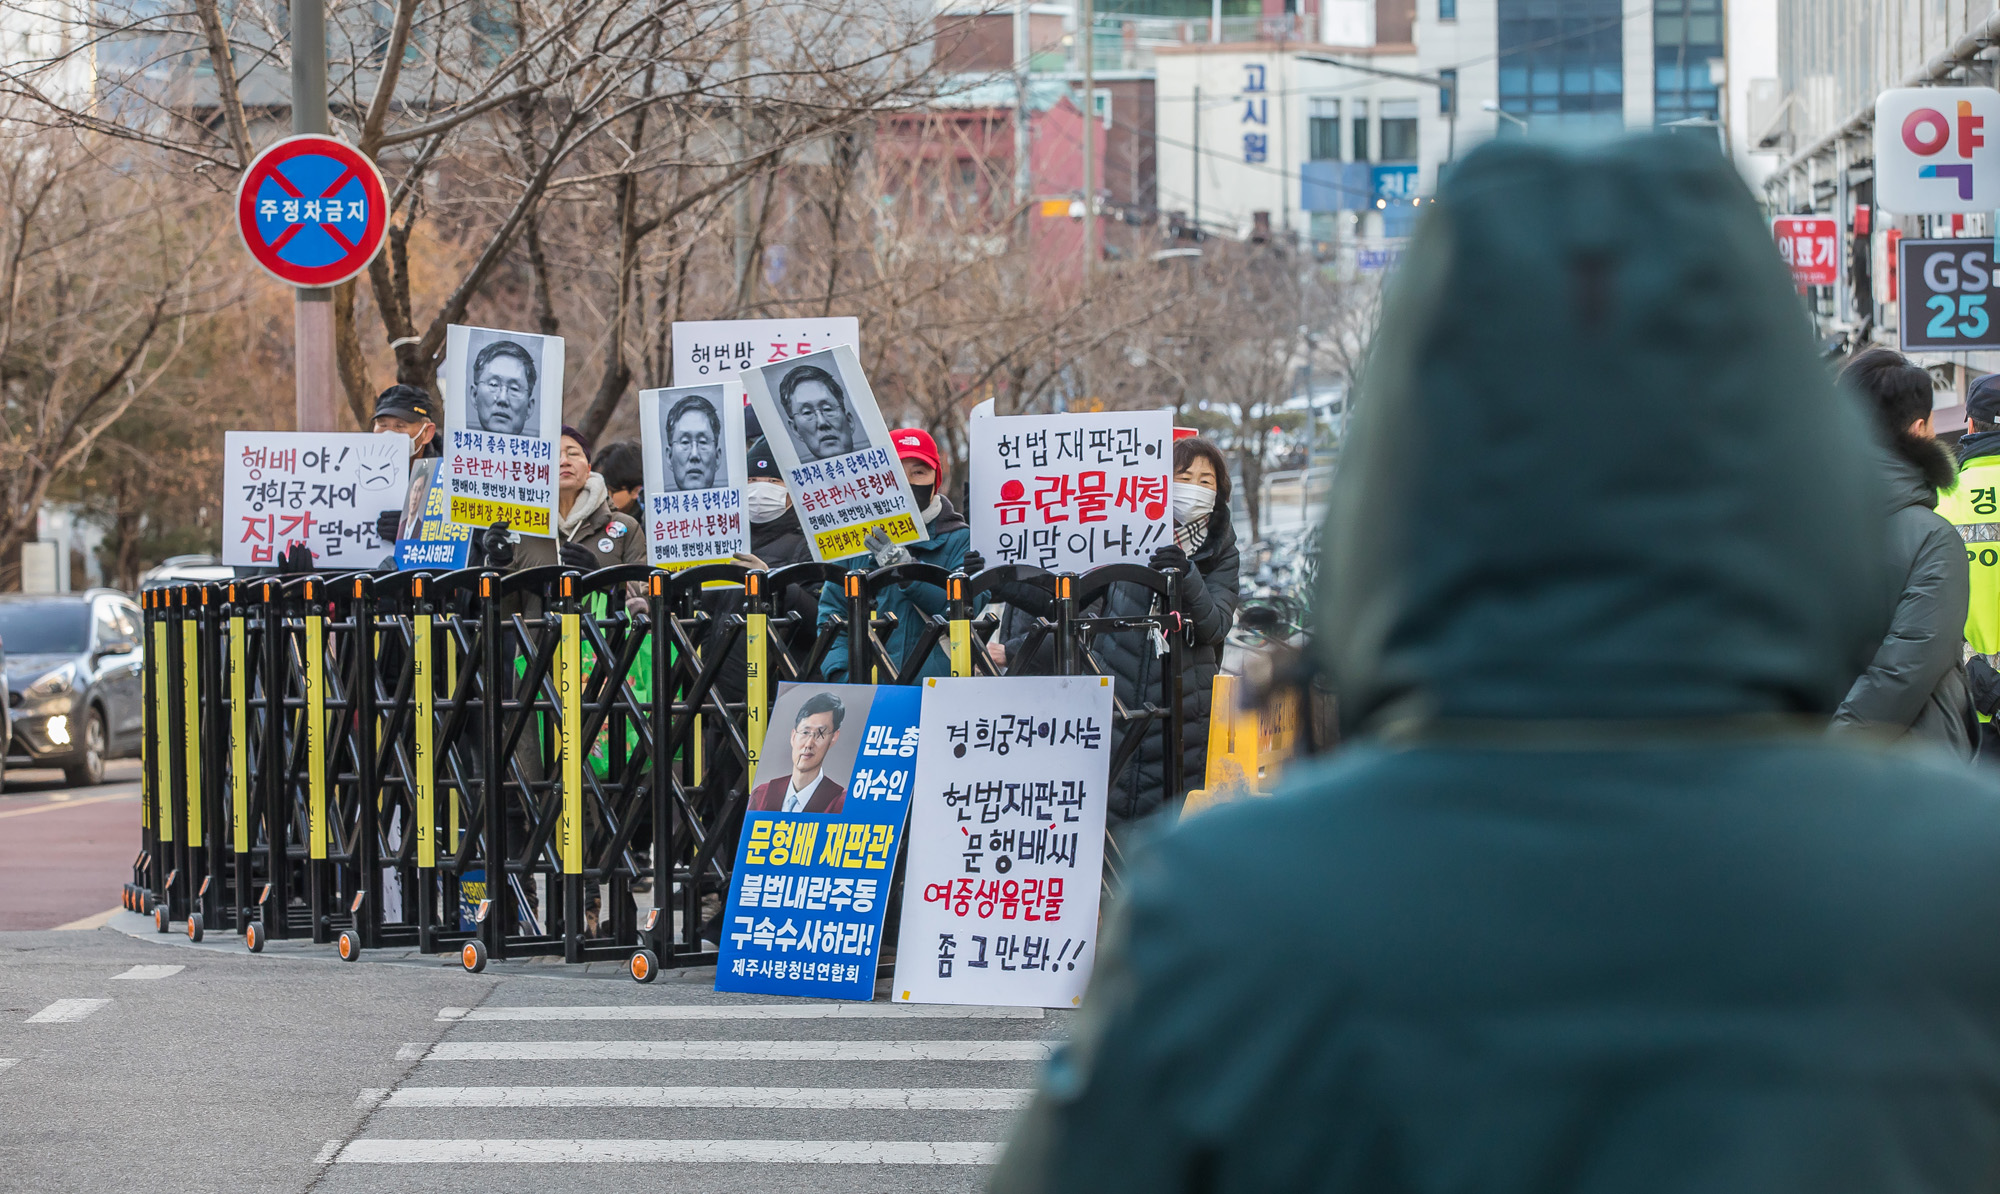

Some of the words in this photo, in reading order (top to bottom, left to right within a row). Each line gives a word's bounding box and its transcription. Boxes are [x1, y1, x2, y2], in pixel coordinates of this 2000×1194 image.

[1241, 64, 1267, 163] 고시원
[1901, 100, 1984, 200] 약
[260, 199, 364, 222] 주정차금지
[1923, 251, 1989, 293] GS
[1926, 294, 1990, 338] 25
[691, 341, 755, 375] 행번방
[1970, 487, 1997, 514] 경
[403, 545, 455, 564] 구속수사하라!
[863, 725, 920, 758] 민노총
[852, 768, 909, 801] 하수인
[942, 780, 1087, 823] 헌법재판관
[745, 820, 820, 867] 문형배
[818, 823, 894, 870] 재판관
[738, 873, 878, 913] 불법내란주동
[924, 877, 1065, 922] 여중생음란물
[730, 916, 875, 957] 구속수사하라!
[938, 933, 957, 978] 좀
[731, 958, 860, 984] 제주사랑청년연합회
